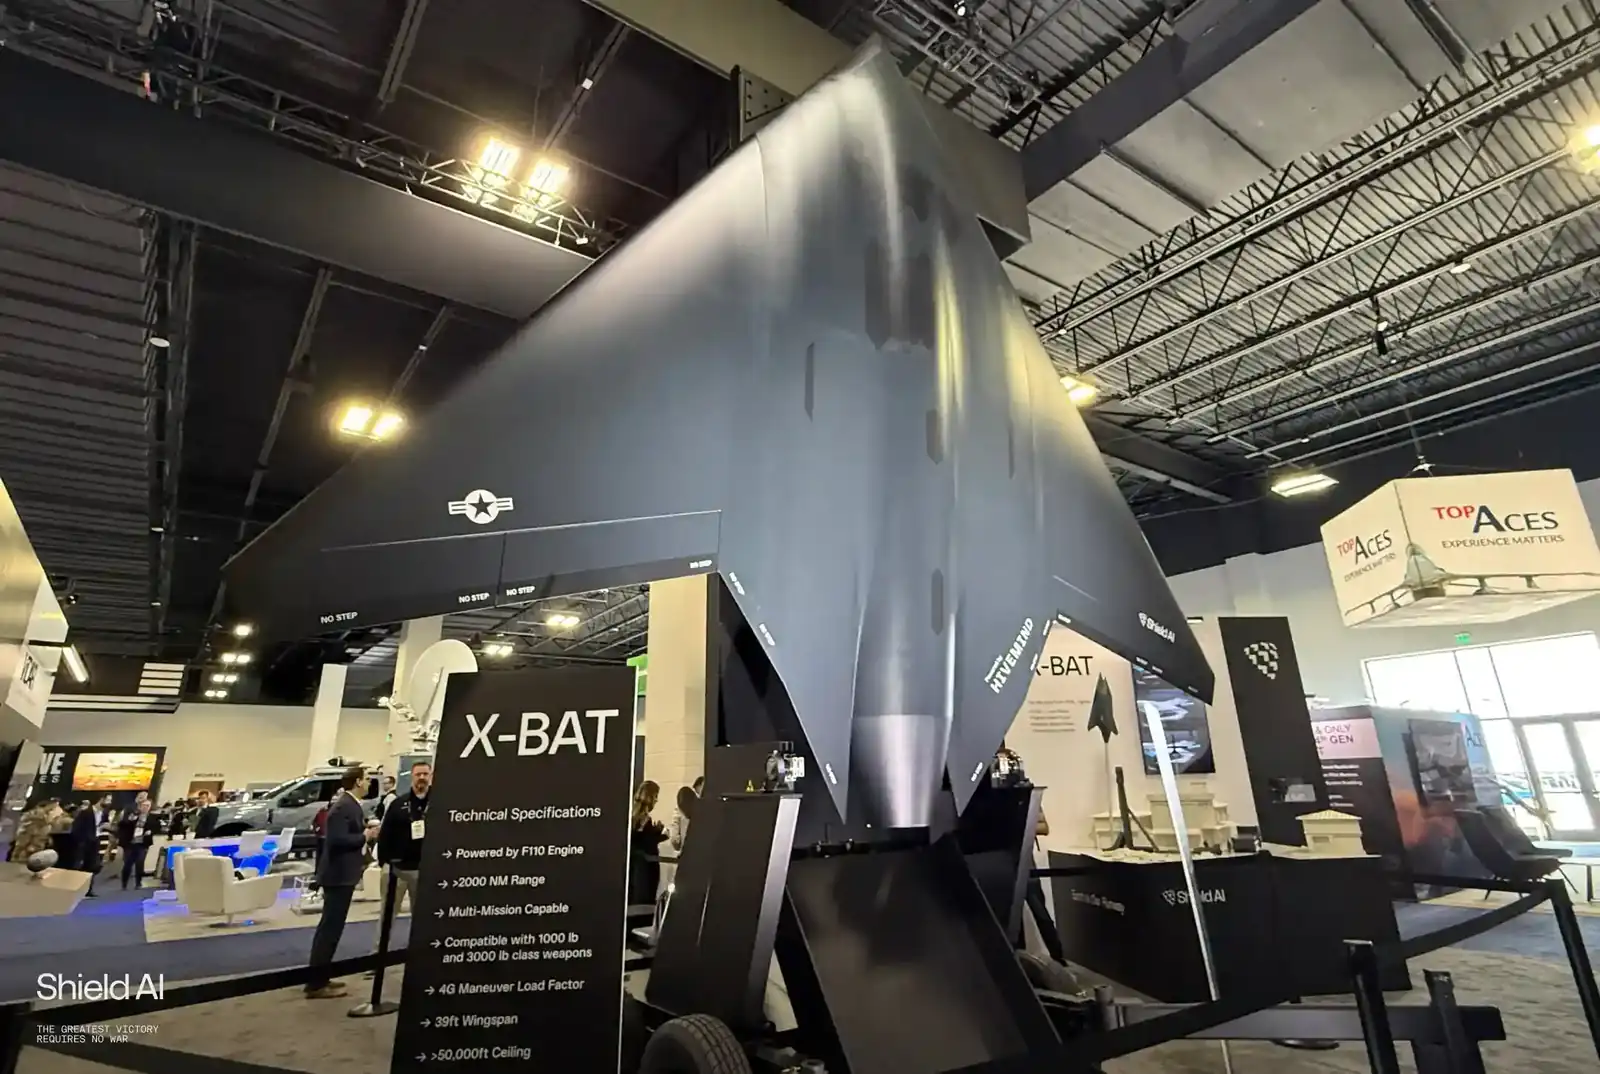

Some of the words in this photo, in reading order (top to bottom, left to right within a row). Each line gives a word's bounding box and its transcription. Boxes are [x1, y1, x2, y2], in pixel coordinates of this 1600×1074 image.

[1431, 505, 1475, 519] TOP
[1473, 505, 1559, 533] ACES
[1336, 538, 1355, 557] TOP
[1354, 529, 1392, 565] ACES
[1442, 537, 1510, 549] EXPERIENCE
[1512, 534, 1565, 544] MATTERS
[458, 595, 471, 603] NO
[471, 592, 490, 602] STEP
[506, 588, 518, 596] NO
[518, 585, 536, 595] STEP
[320, 615, 335, 624] NO
[335, 611, 358, 622] STEP
[990, 617, 1034, 694] HIVEMIND
[460, 709, 620, 759] X-BAT
[1330, 735, 1354, 744] GEN
[448, 808, 509, 823] Technical
[510, 805, 602, 823] Specifications
[456, 846, 504, 860] Powered
[506, 846, 519, 860] by
[521, 845, 546, 857] F110
[547, 844, 585, 857] Engine
[452, 876, 488, 889] >2000
[489, 875, 509, 887] NM
[510, 874, 546, 888] Range
[1214, 888, 1226, 903] AI
[448, 904, 523, 918] Multi-Mission
[524, 902, 570, 916] Capable
[444, 935, 509, 949] Compatible
[510, 934, 536, 946] with
[538, 932, 567, 945] 1000
[568, 931, 580, 944] lb
[442, 952, 464, 964] and
[466, 950, 497, 963] 3000
[498, 950, 510, 961] lb
[511, 949, 541, 961] class
[542, 947, 593, 962] weapons
[438, 983, 457, 996] 4G
[458, 982, 516, 995] Maneuver
[517, 980, 546, 992] Load
[547, 978, 586, 991] Factor
[434, 1015, 461, 1028] 39ft
[462, 1013, 519, 1029] Wingspan
[430, 1048, 490, 1062] >50,000ft
[491, 1045, 532, 1061] Ceiling
